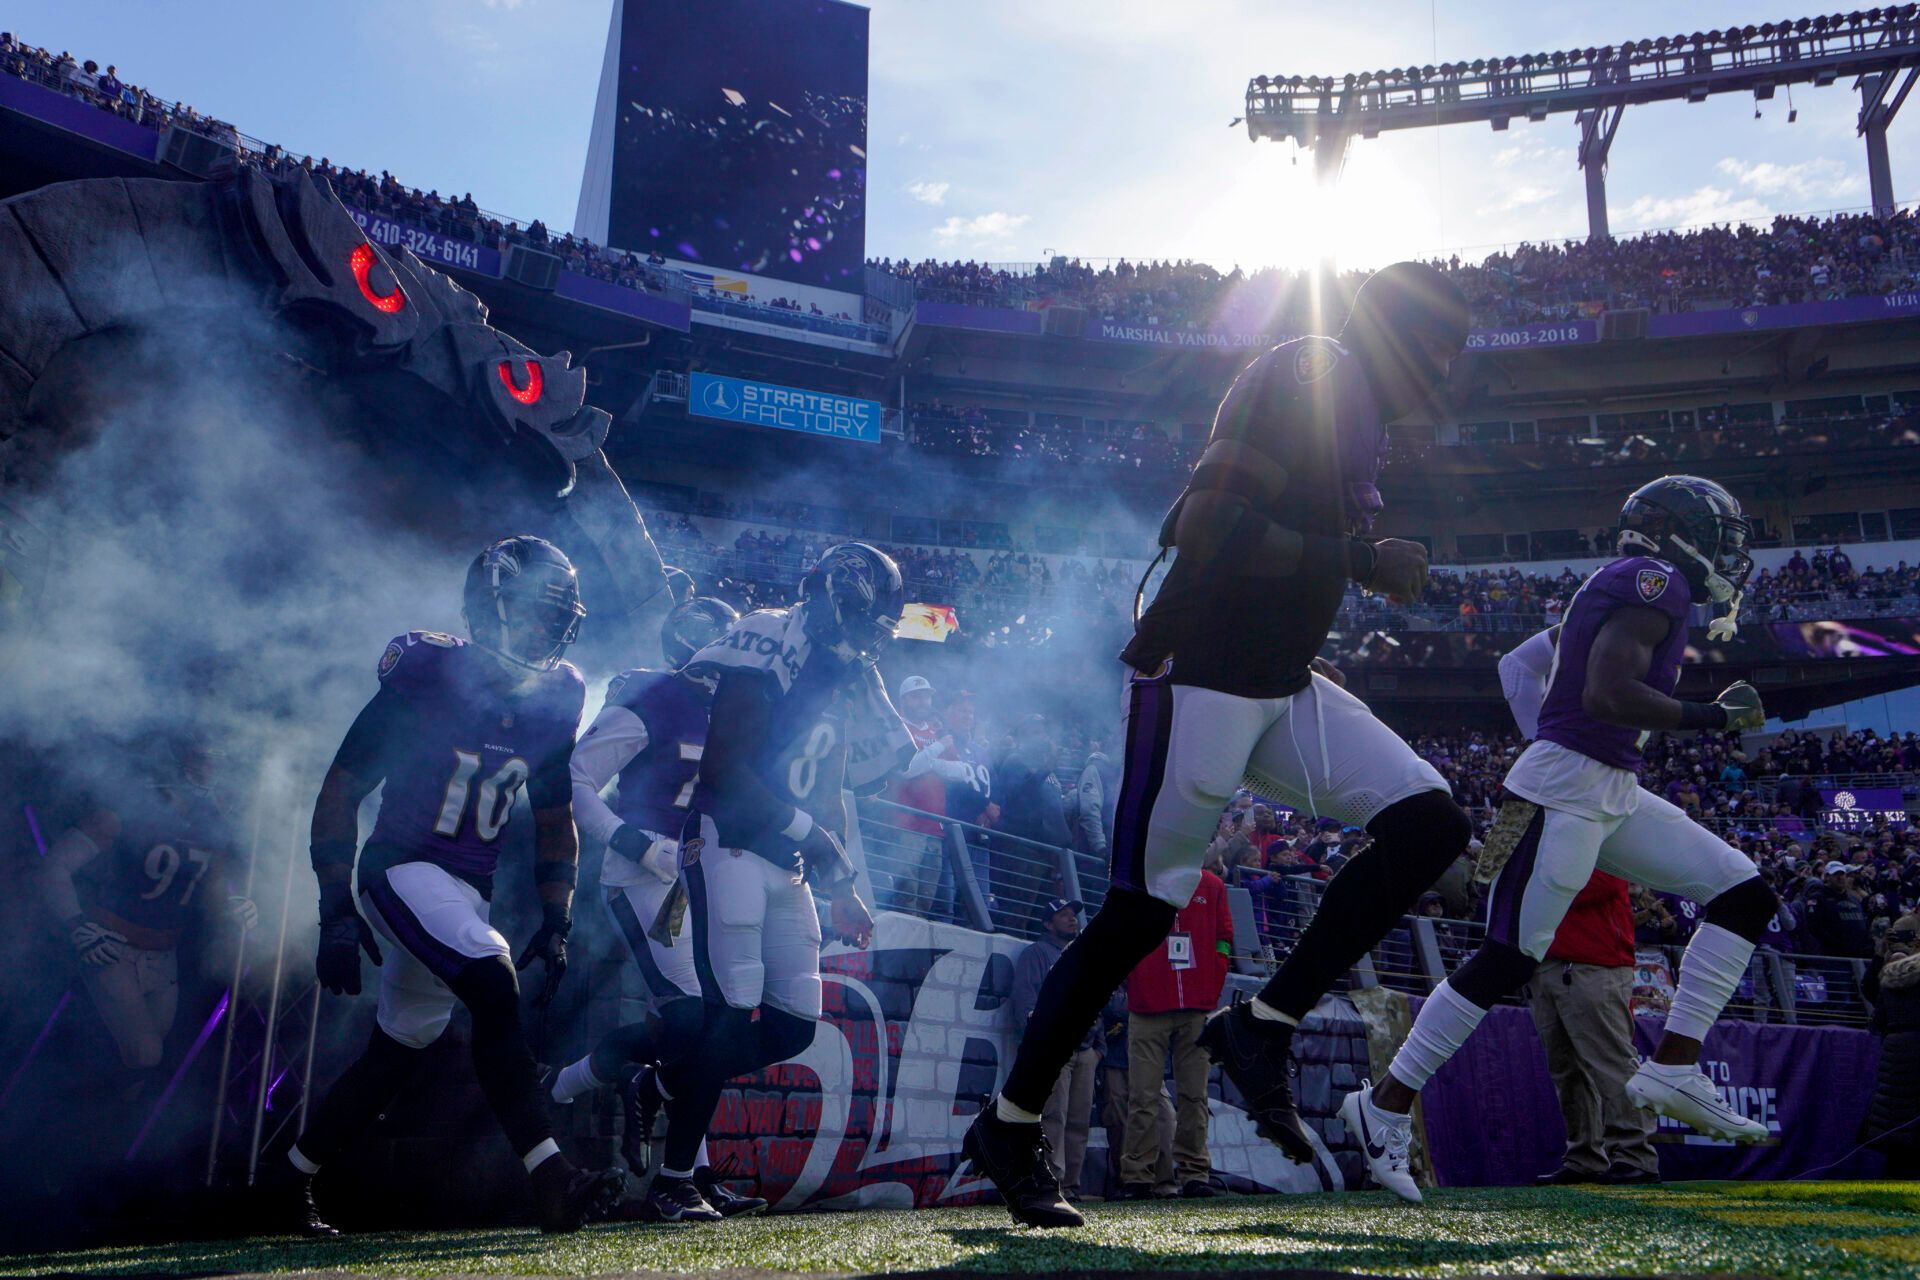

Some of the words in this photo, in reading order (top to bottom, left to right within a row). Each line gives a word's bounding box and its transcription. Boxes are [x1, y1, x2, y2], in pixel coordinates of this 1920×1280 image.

[370, 219, 479, 269] 410-324-6141
[1102, 325, 1172, 344] MARSHAL
[1176, 331, 1229, 347] YANDA
[1490, 327, 1578, 347] 2003-2018
[742, 402, 868, 437] FACTORY
[743, 385, 870, 419] STRATEGIC
[484, 743, 515, 754] RAVENS
[787, 722, 836, 800] 8
[432, 746, 531, 841] 10
[672, 741, 704, 810] 7
[140, 844, 211, 906] 97
[1706, 1060, 1731, 1083] TO
[707, 1095, 799, 1135] ALWAYS
